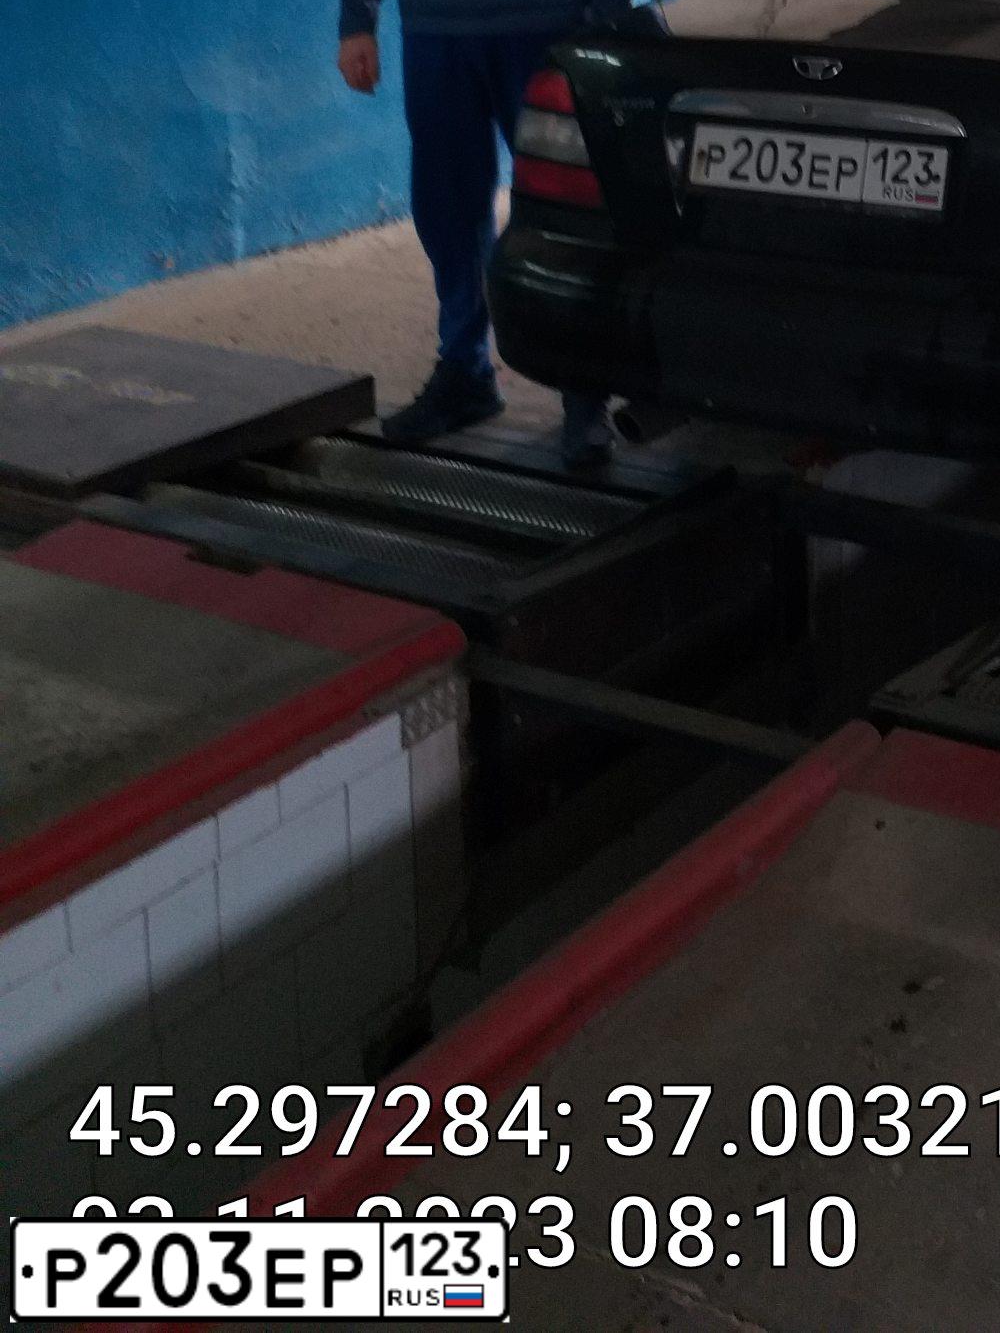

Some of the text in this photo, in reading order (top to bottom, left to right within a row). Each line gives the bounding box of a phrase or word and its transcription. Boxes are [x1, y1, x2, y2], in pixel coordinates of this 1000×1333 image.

[703, 136, 939, 192] Р203ЕР 123
[882, 186, 915, 202] RUS
